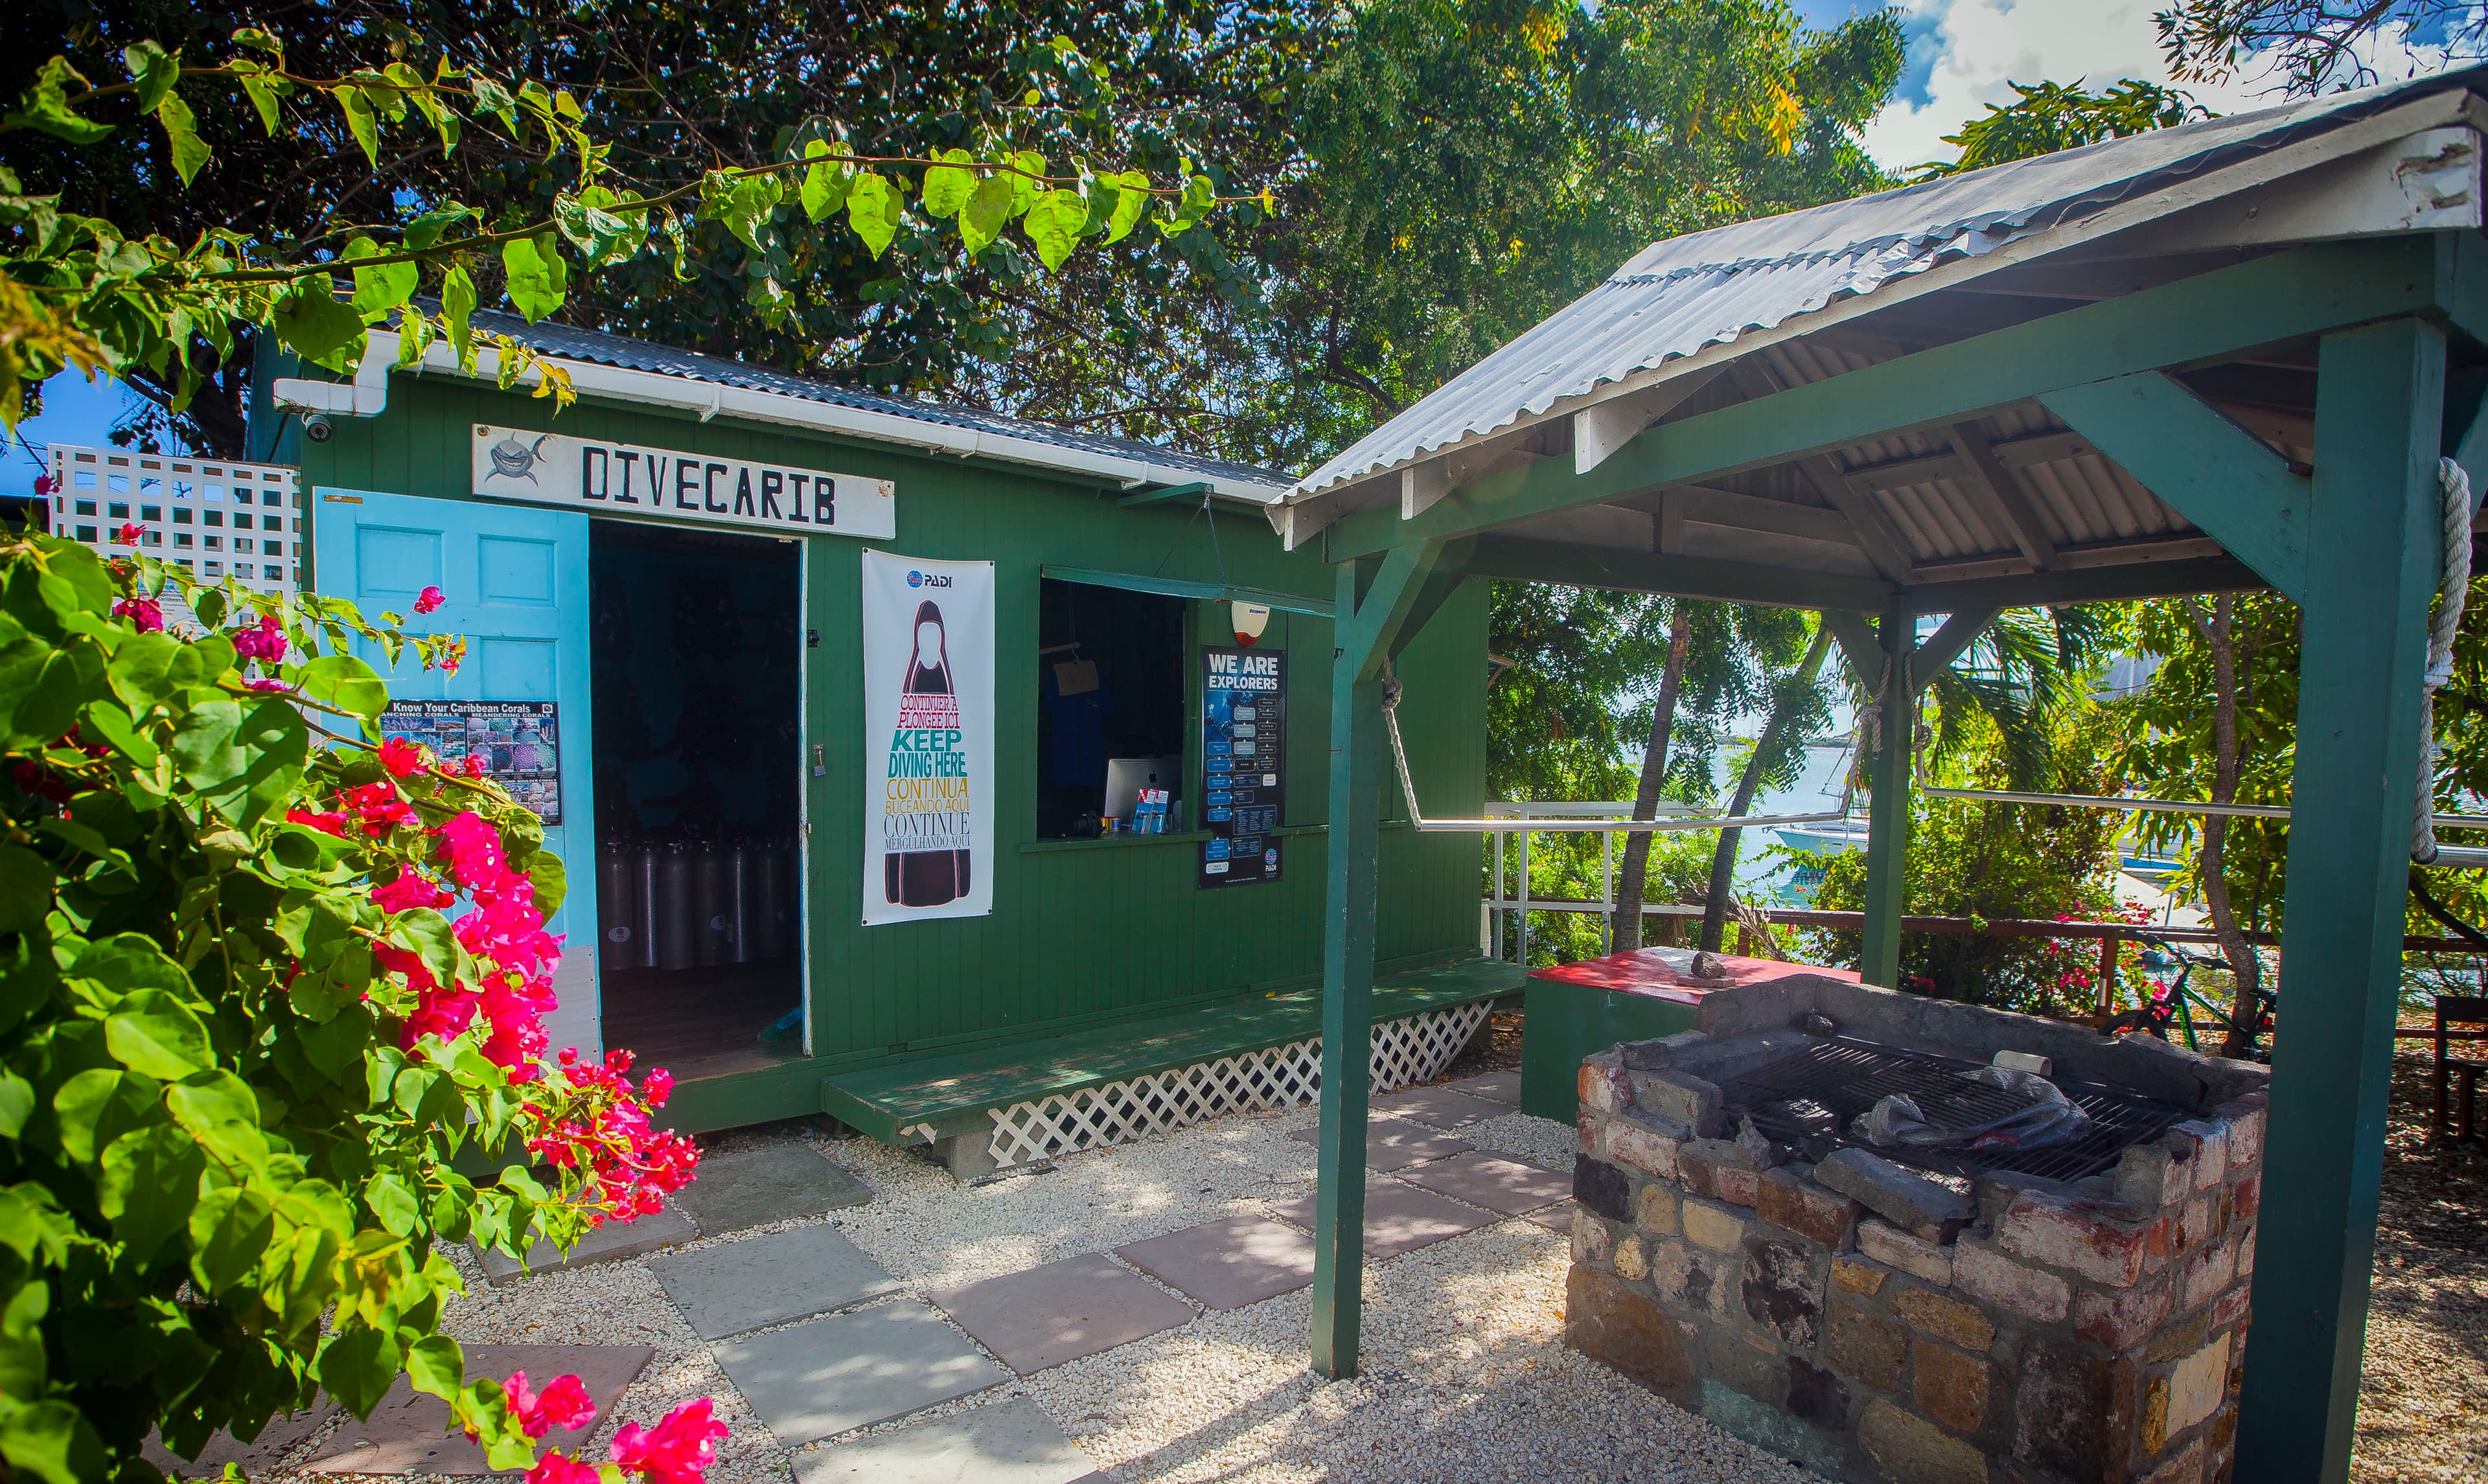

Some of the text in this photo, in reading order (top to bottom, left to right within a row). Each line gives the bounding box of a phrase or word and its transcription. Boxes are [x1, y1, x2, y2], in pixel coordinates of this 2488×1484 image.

[582, 446, 836, 526] DIVECARIB
[925, 574, 953, 588] PADI
[1208, 654, 1278, 675] WE ARE
[1209, 676, 1278, 691] EXPLORERS
[393, 703, 530, 714] Know Your Caribbean Corals
[901, 695, 949, 711] CONTINUER
[945, 713, 960, 729] ICI
[891, 729, 962, 752] KEEP
[888, 752, 968, 778] DIVING HERE
[886, 774, 968, 800] CONTINÚA
[885, 795, 969, 814] BUCEANDO AQUÍ
[884, 812, 971, 838] CONTINUE
[884, 834, 971, 850] MERGULHANDO AQUI
